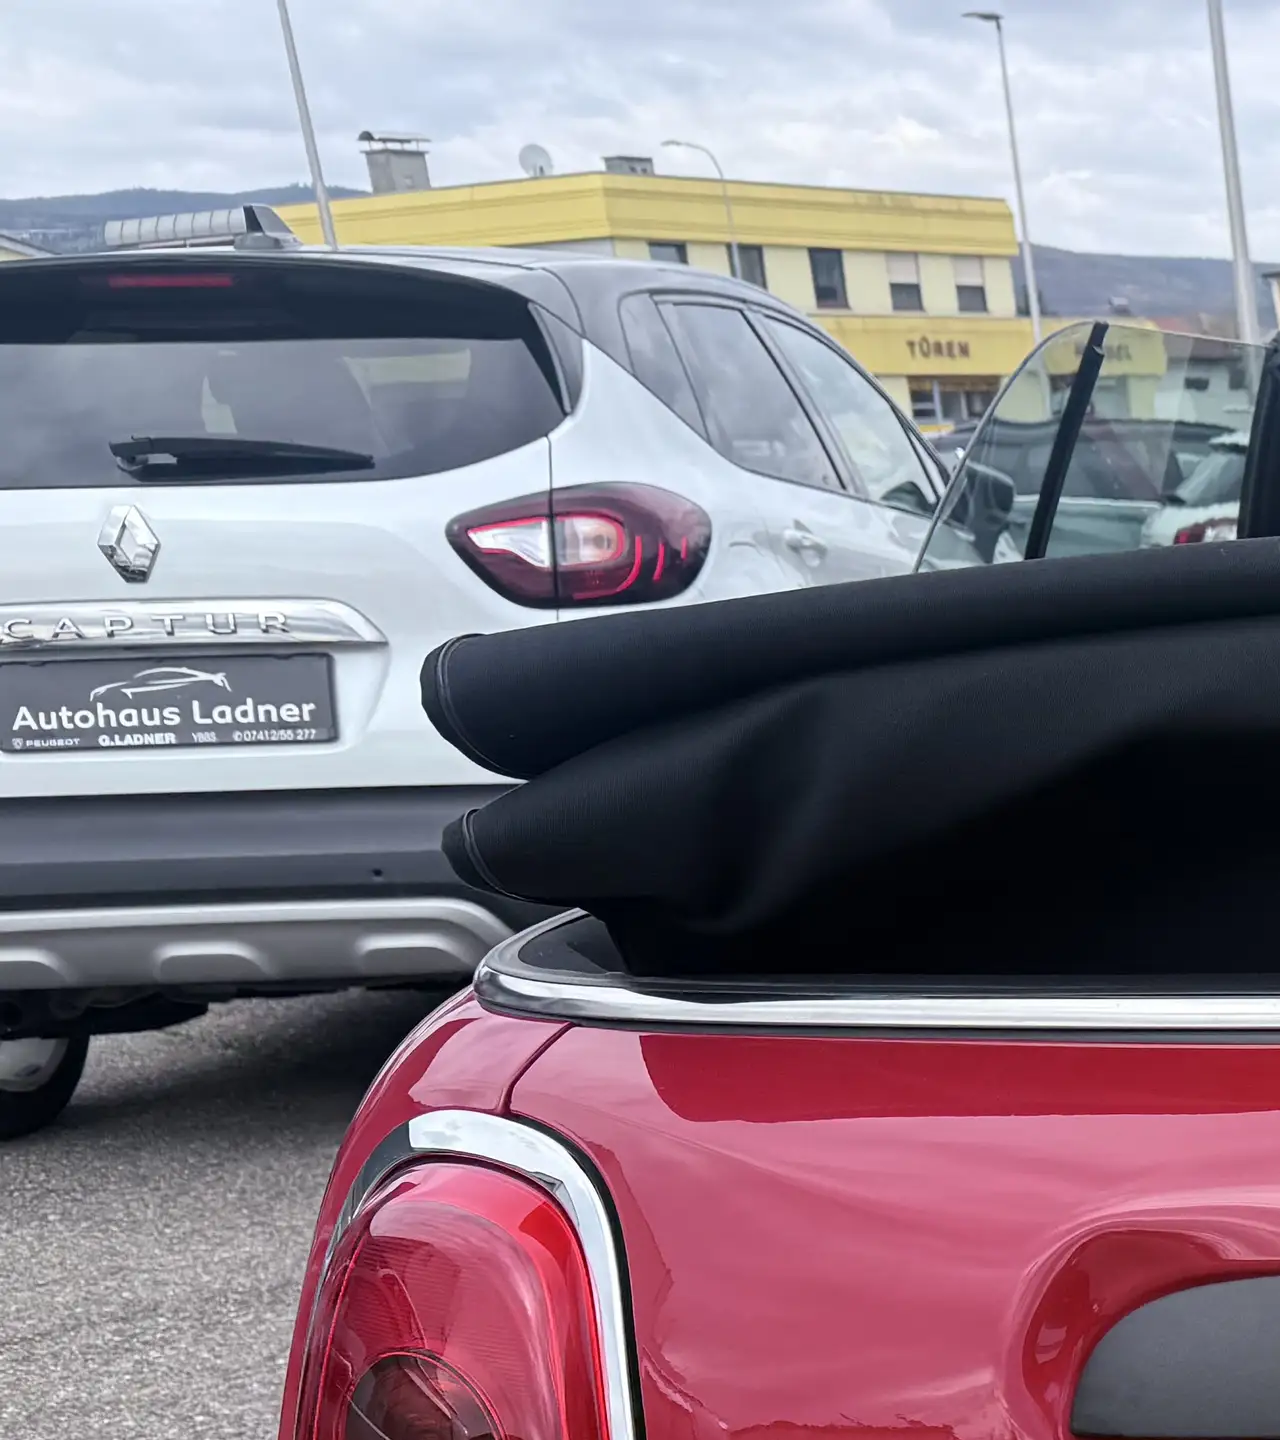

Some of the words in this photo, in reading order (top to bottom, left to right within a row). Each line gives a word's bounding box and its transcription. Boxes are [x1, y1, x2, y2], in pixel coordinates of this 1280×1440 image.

[2, 612, 290, 640] CAPTUR
[12, 702, 181, 731] Autohaus
[191, 697, 317, 724] Ladner
